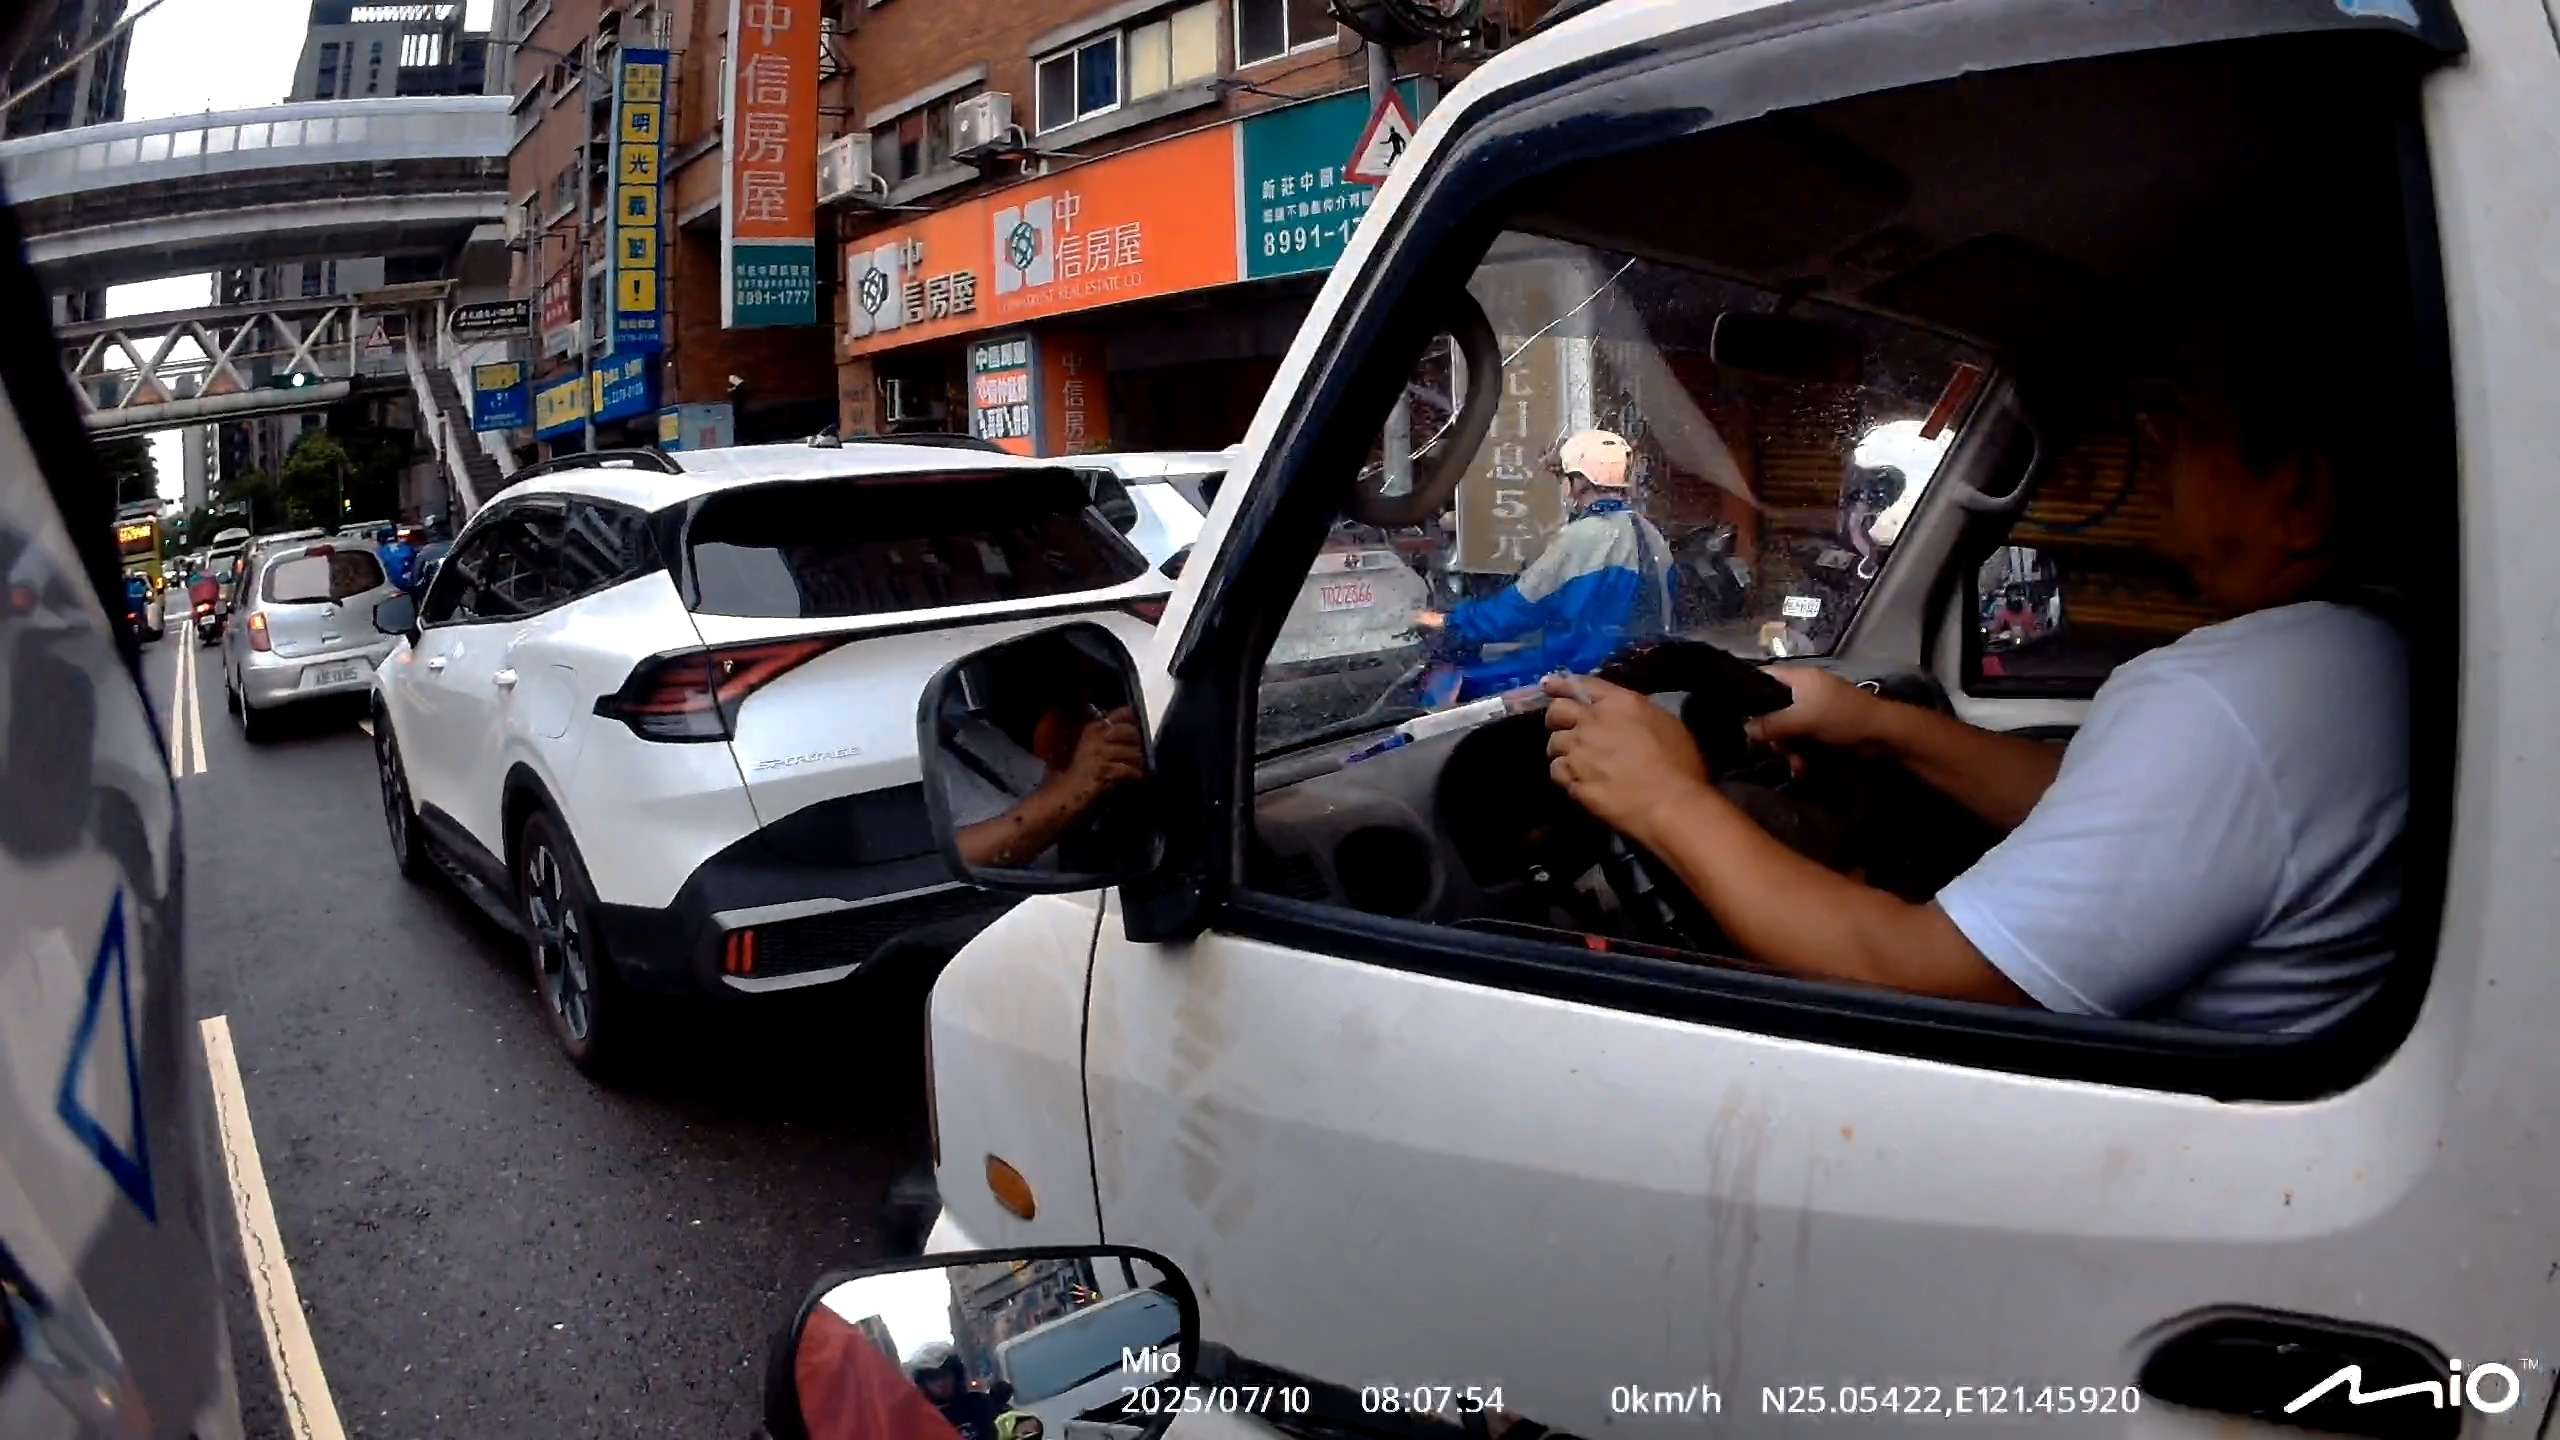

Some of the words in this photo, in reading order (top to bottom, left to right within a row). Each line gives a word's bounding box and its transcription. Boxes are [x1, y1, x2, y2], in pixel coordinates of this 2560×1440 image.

[739, 0, 792, 223] 中信房屋
[1055, 190, 1080, 233] 中
[1055, 221, 1143, 281] 信房屋
